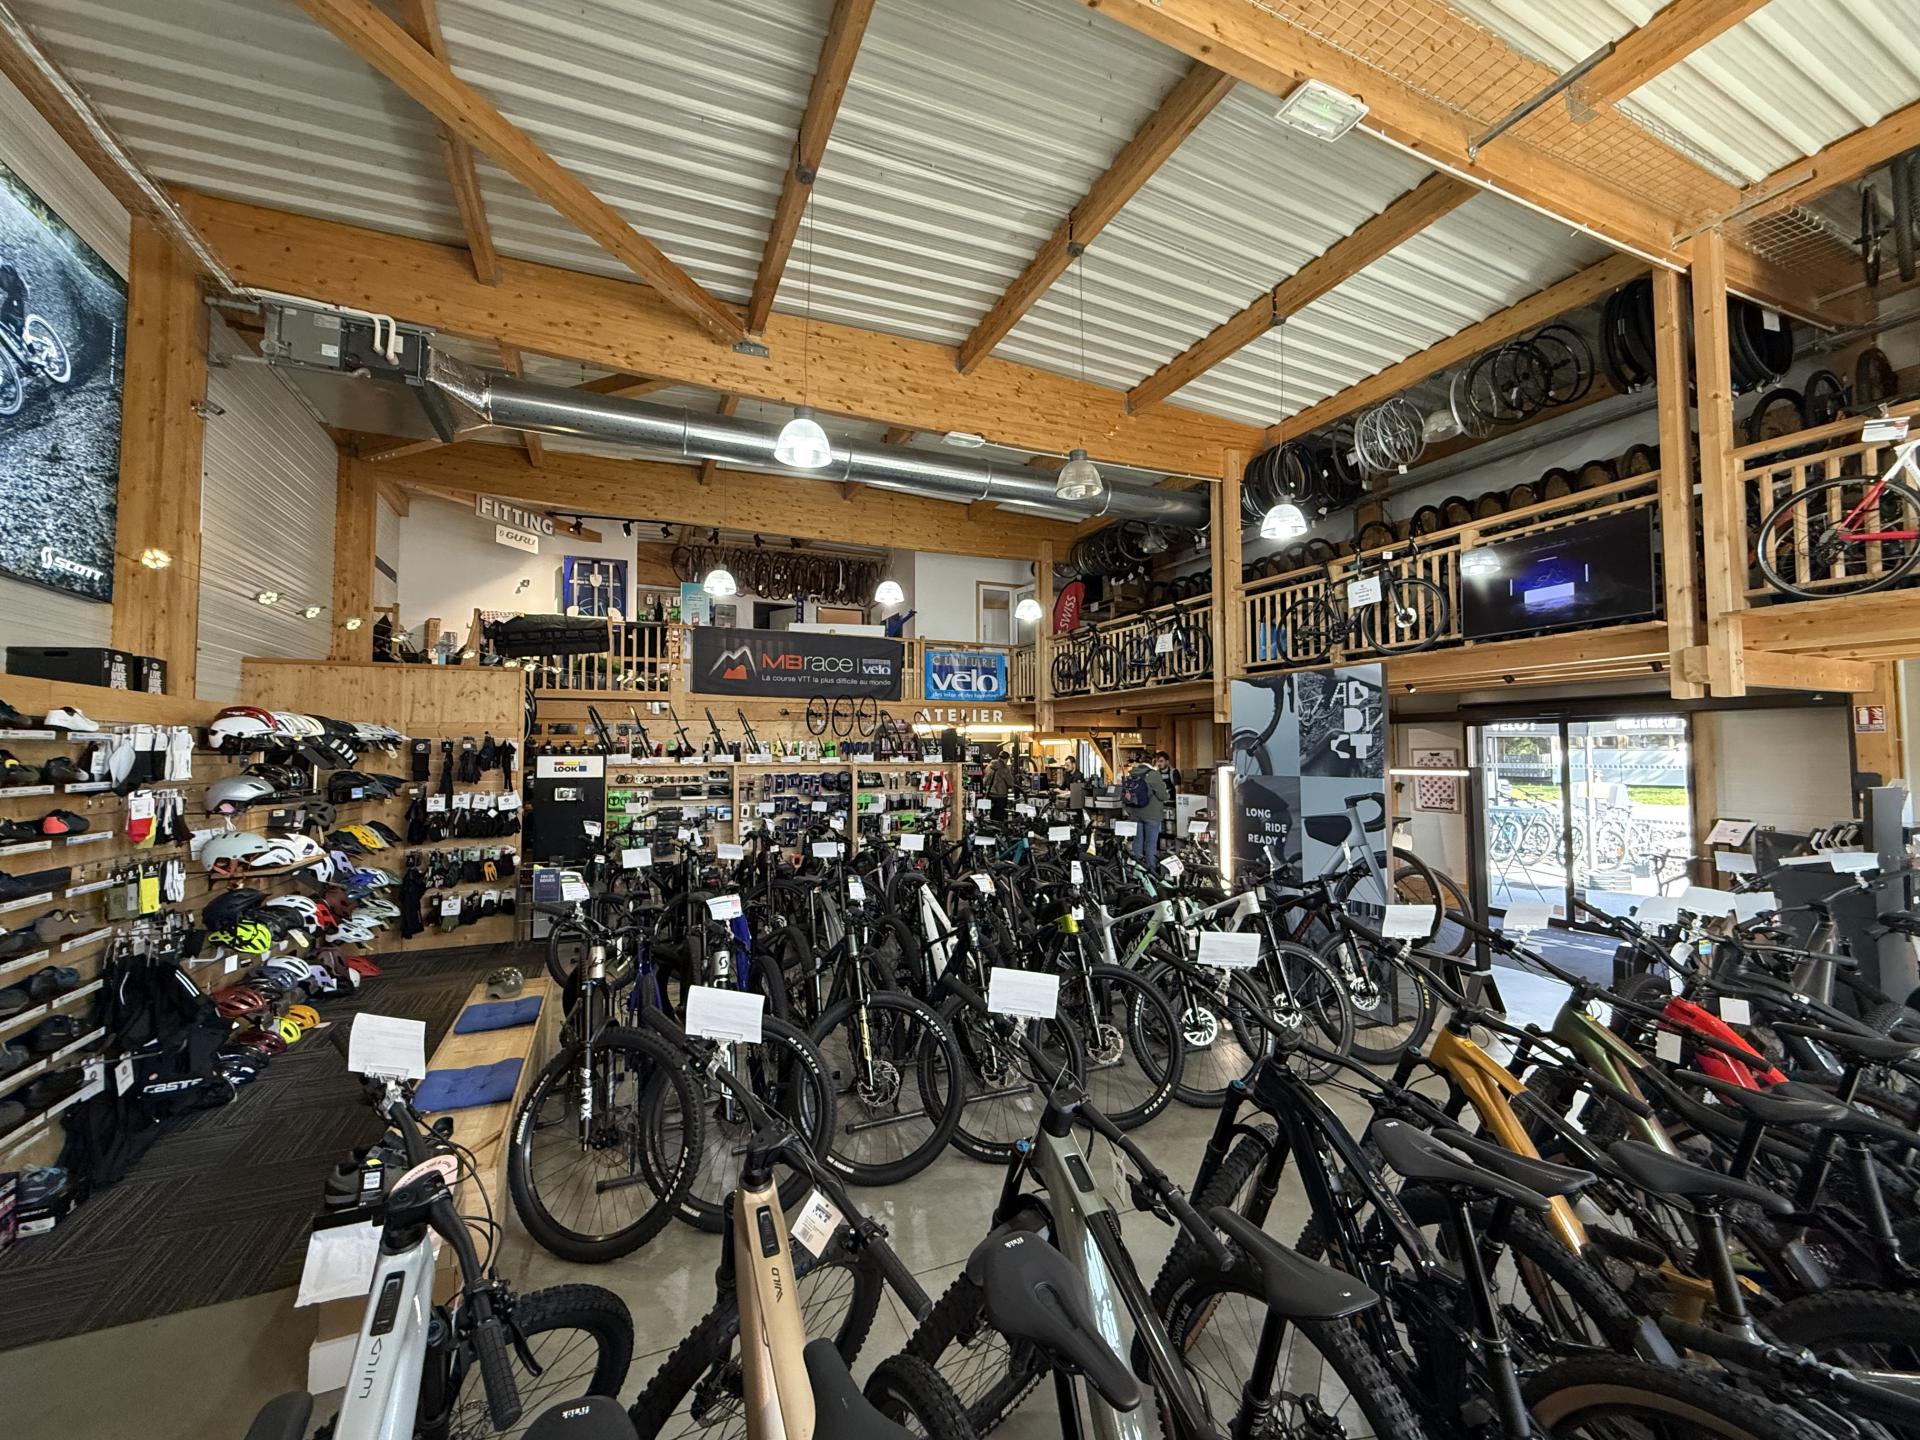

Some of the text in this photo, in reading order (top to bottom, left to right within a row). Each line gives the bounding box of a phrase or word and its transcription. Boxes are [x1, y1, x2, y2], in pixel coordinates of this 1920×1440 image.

[481, 497, 554, 535] FITTING
[505, 531, 536, 546] GURU
[53, 556, 104, 581] SCOTT
[1059, 594, 1077, 629] SWISS
[762, 653, 854, 673] MBrace
[797, 675, 811, 683] VTT
[920, 708, 1003, 723] ATELIER
[1246, 807, 1271, 818] LONG
[1248, 833, 1278, 845] READY
[1265, 822, 1287, 833] RIDE
[914, 1009, 948, 1042] MAXXIS
[787, 1036, 821, 1075] MAXXIS
[1143, 1083, 1171, 1115] MAXXIS
[664, 1146, 689, 1202] MAXXIS
[1386, 1194, 1407, 1223] FUEL
[771, 1267, 784, 1303] WILD
[1180, 1303, 1193, 1320] DT
[1173, 1315, 1186, 1346] SWISS
[359, 1337, 382, 1398] WILD
